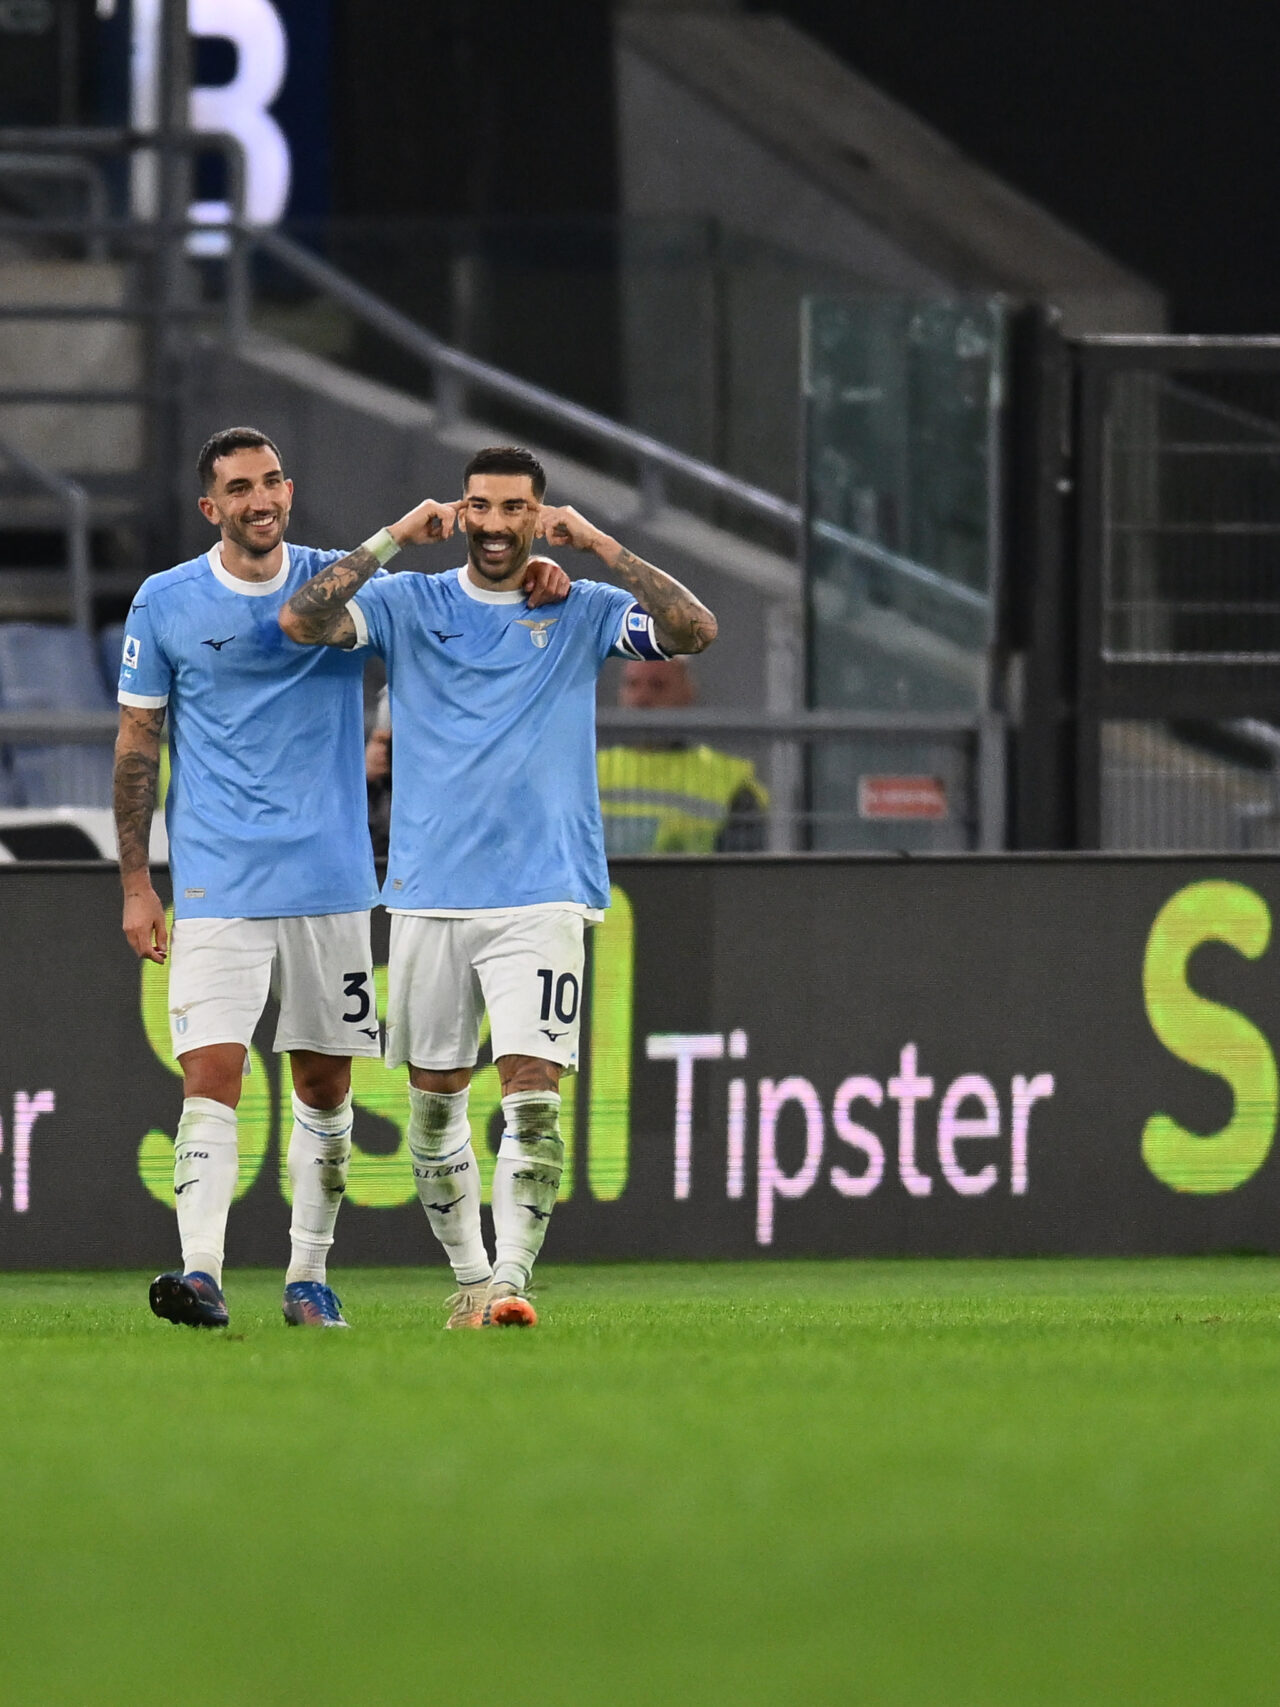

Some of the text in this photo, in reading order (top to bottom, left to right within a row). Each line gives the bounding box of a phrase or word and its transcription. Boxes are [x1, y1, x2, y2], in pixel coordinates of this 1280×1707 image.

[537, 969, 580, 1025] 10
[1141, 879, 1280, 1195] S
[646, 1029, 1055, 1245] Tipster
